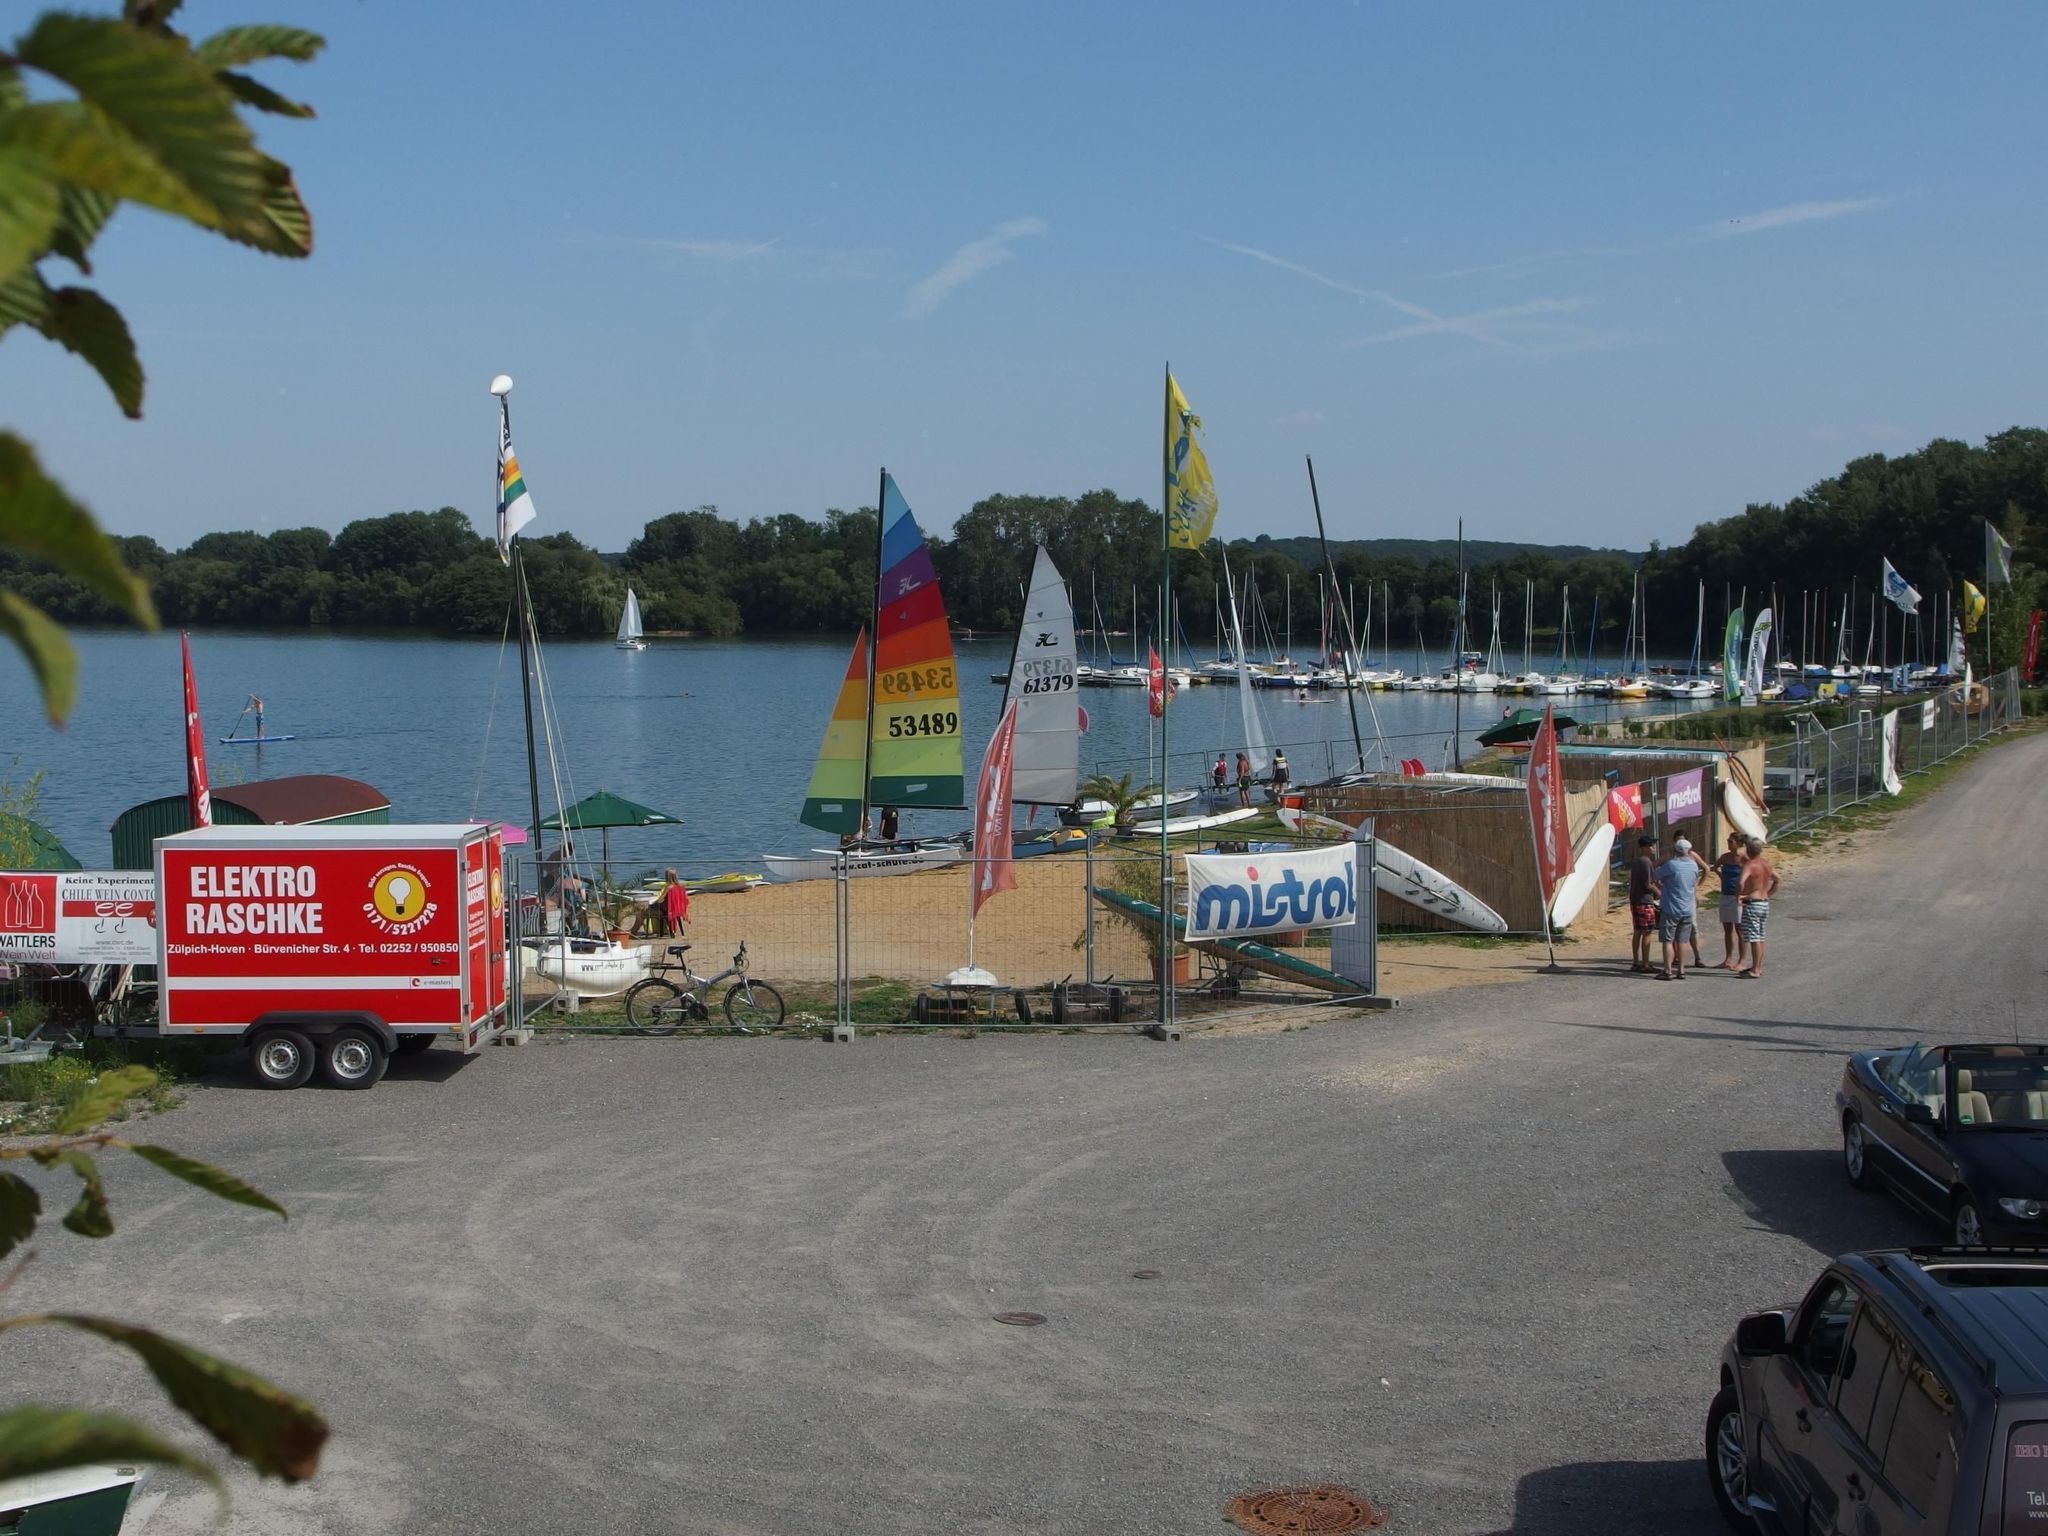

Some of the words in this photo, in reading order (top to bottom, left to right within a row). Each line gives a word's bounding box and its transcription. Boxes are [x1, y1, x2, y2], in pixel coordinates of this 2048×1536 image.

[1024, 674, 1073, 694] 61379
[889, 712, 958, 738] 53489
[1668, 782, 1702, 810] mistral
[62, 889, 92, 900] CHILE
[96, 889, 120, 900] WEIN
[190, 865, 316, 898] ELEKTRO
[1196, 861, 1356, 930] mistral
[186, 902, 323, 934] RASCHKE
[362, 902, 438, 935] 0171/5227228
[168, 943, 245, 956] Zülpich-Hoven
[254, 944, 320, 954] Bürvenicher
[322, 944, 341, 954] Str.
[343, 944, 350, 952] 4
[358, 944, 377, 952] Tel.
[380, 944, 412, 952] 02252
[420, 943, 458, 952] 950850
[2026, 1491, 2048, 1506] Tel.
